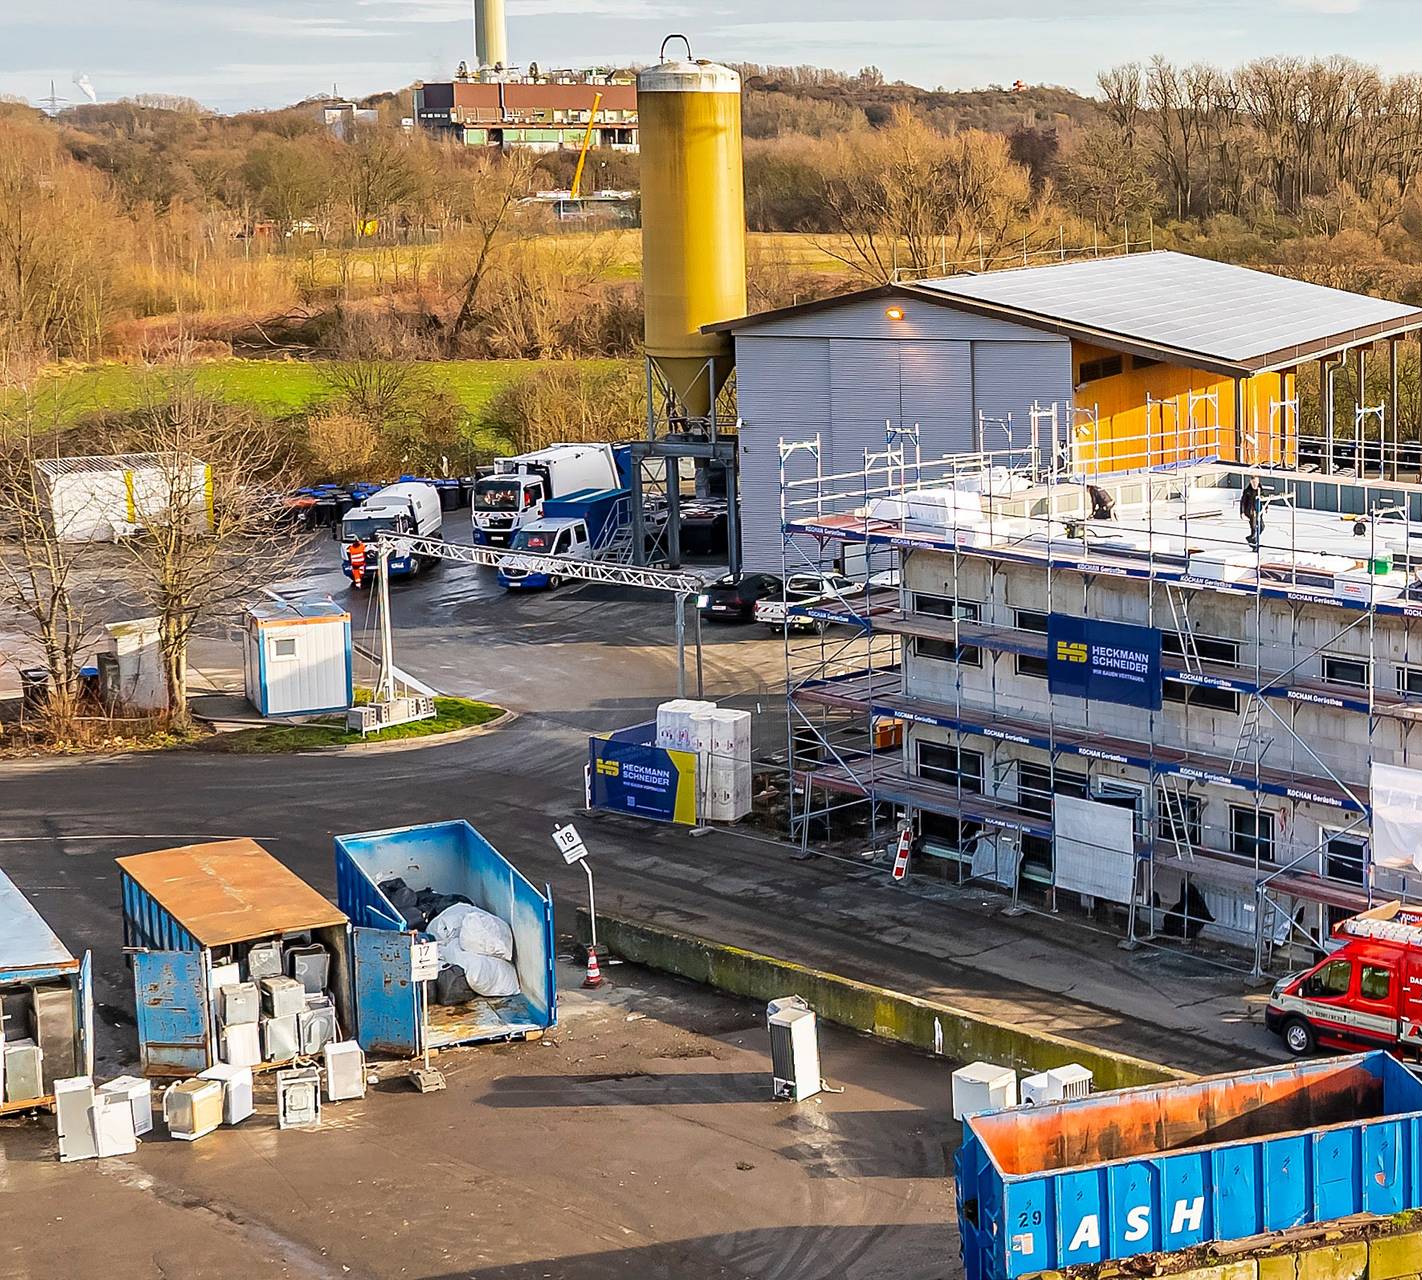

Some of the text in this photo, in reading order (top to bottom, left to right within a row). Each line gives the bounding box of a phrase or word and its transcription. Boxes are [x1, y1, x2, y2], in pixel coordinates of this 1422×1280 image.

[1180, 575, 1204, 584] KOCHAN
[1287, 592, 1343, 607] KOCHAN Gerüstbau
[1091, 645, 1149, 664] HECKMANN
[1091, 655, 1148, 674] SCHNEIDER
[1179, 672, 1203, 682] KOCHAN
[1287, 690, 1312, 700] KOCHAN
[983, 728, 1005, 738] KOCHAN
[1078, 747, 1101, 757] KOCHAN
[622, 763, 670, 778] HECKMANN
[1179, 767, 1203, 778] KOCHAN
[622, 771, 670, 786] SCHNEIDER
[1286, 788, 1342, 806] KOCHAN Gerüstbau
[559, 831, 575, 846] 18
[418, 945, 430, 957] 17
[1018, 1210, 1042, 1228] 29
[1068, 1196, 1204, 1251] ASH
